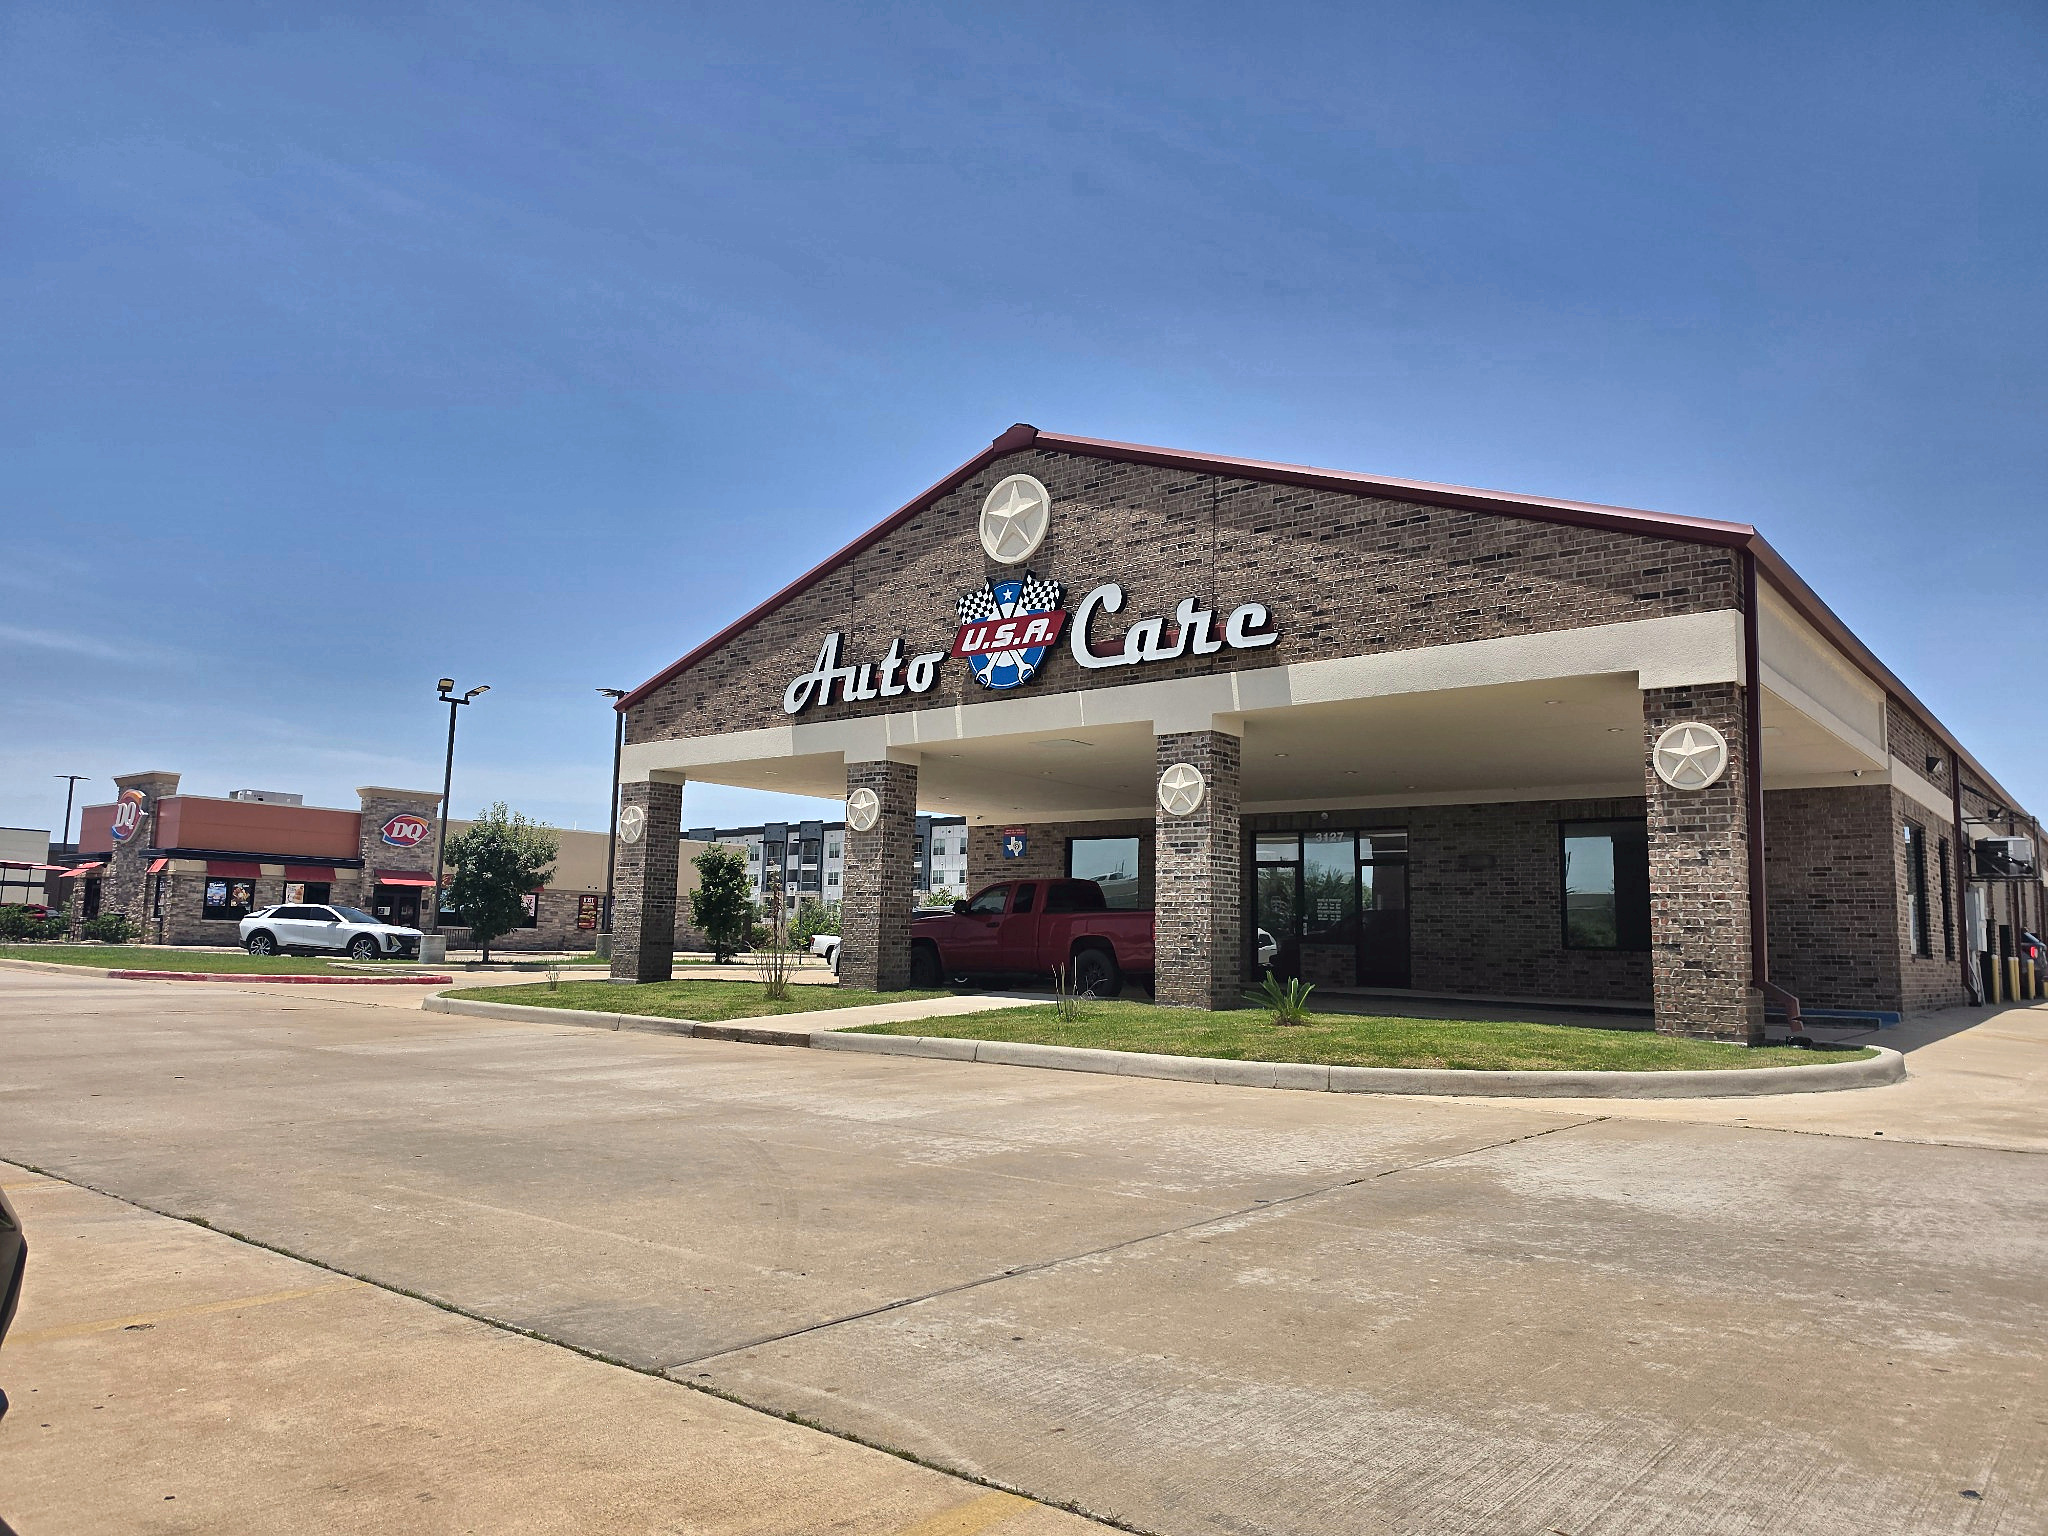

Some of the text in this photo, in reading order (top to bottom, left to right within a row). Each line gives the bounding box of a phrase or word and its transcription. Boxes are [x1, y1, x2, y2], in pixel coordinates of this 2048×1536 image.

[783, 582, 1280, 714] Auto U.S.A. Care
[115, 801, 137, 829] DQ
[390, 822, 423, 841] DQ
[1315, 831, 1344, 842] 3127
